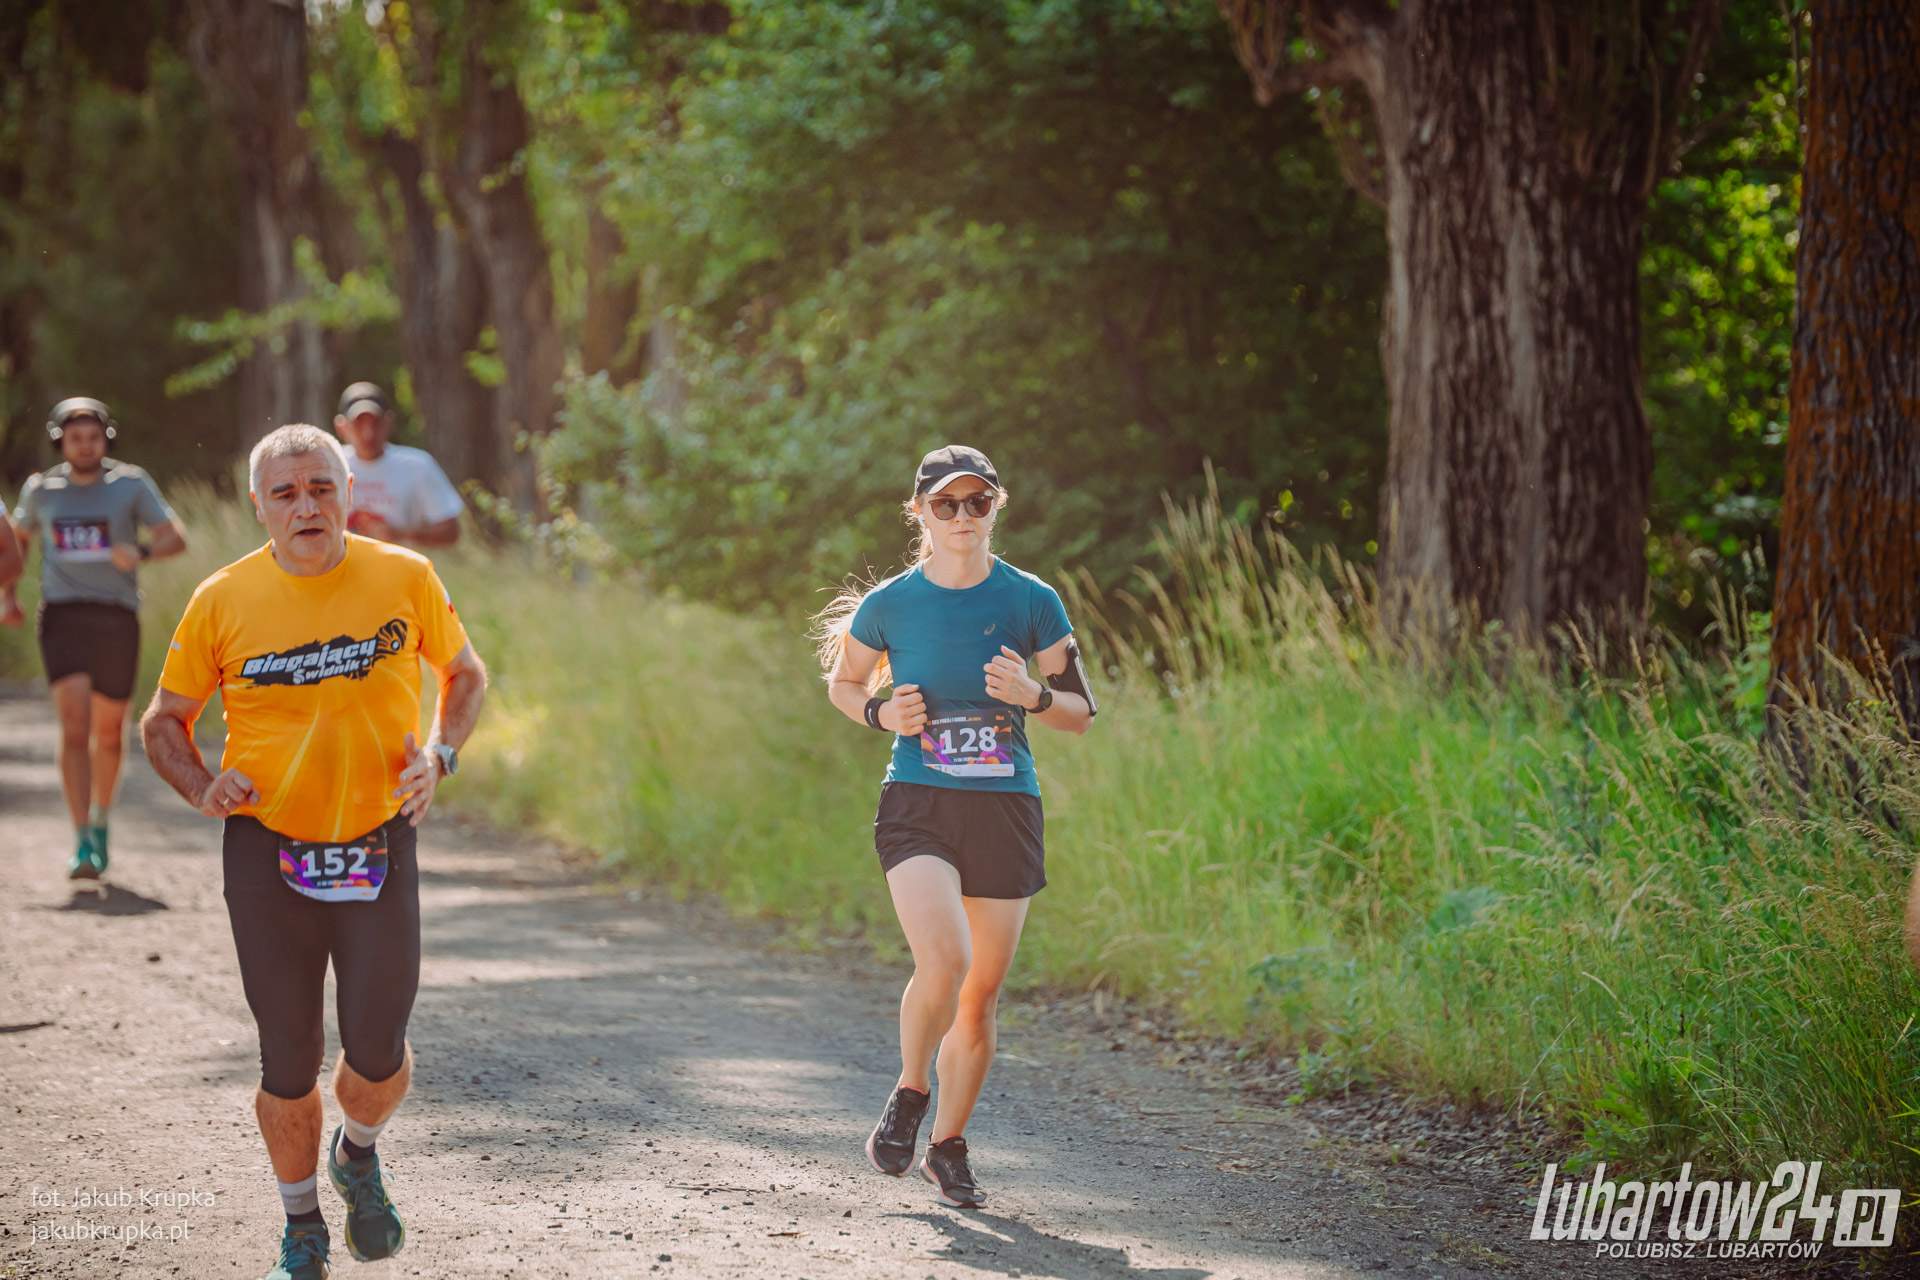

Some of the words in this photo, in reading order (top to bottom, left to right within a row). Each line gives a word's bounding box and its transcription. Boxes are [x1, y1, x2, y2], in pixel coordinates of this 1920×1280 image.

[242, 639, 377, 675] Biegający
[940, 727, 997, 754] 128
[301, 847, 368, 878] 152
